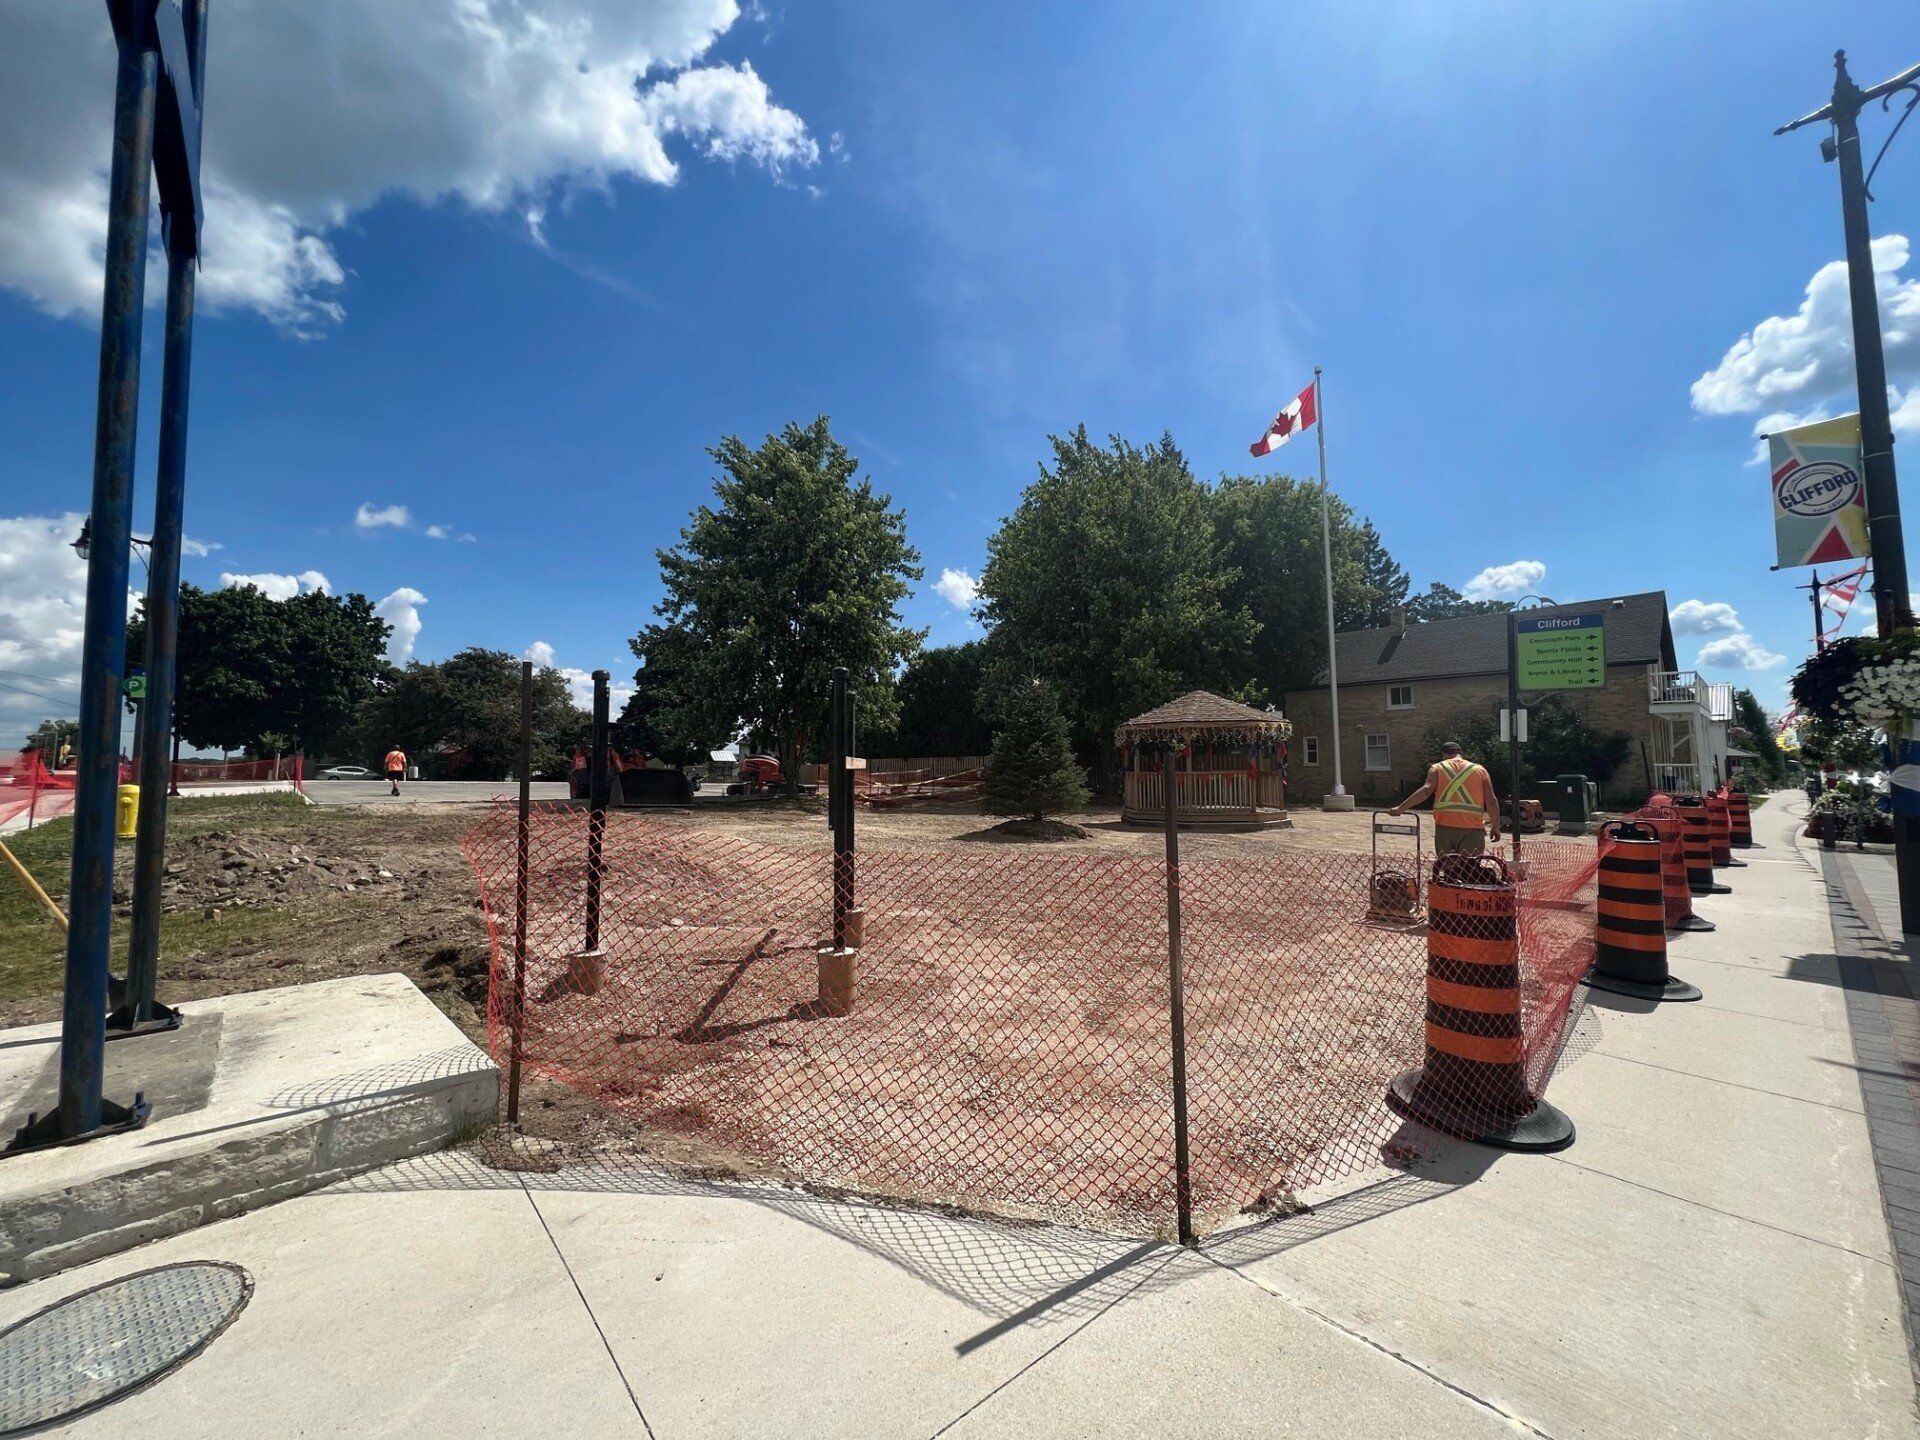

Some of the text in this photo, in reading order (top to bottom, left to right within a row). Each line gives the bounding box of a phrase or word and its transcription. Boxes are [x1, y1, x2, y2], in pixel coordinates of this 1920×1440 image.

[1778, 470, 1858, 509] CLIFFORD
[1538, 618, 1580, 629] Clifford
[1526, 657, 1566, 666] Community
[129, 680, 140, 690] P
[1455, 893, 1482, 911] Town
[1483, 896, 1493, 912] of
